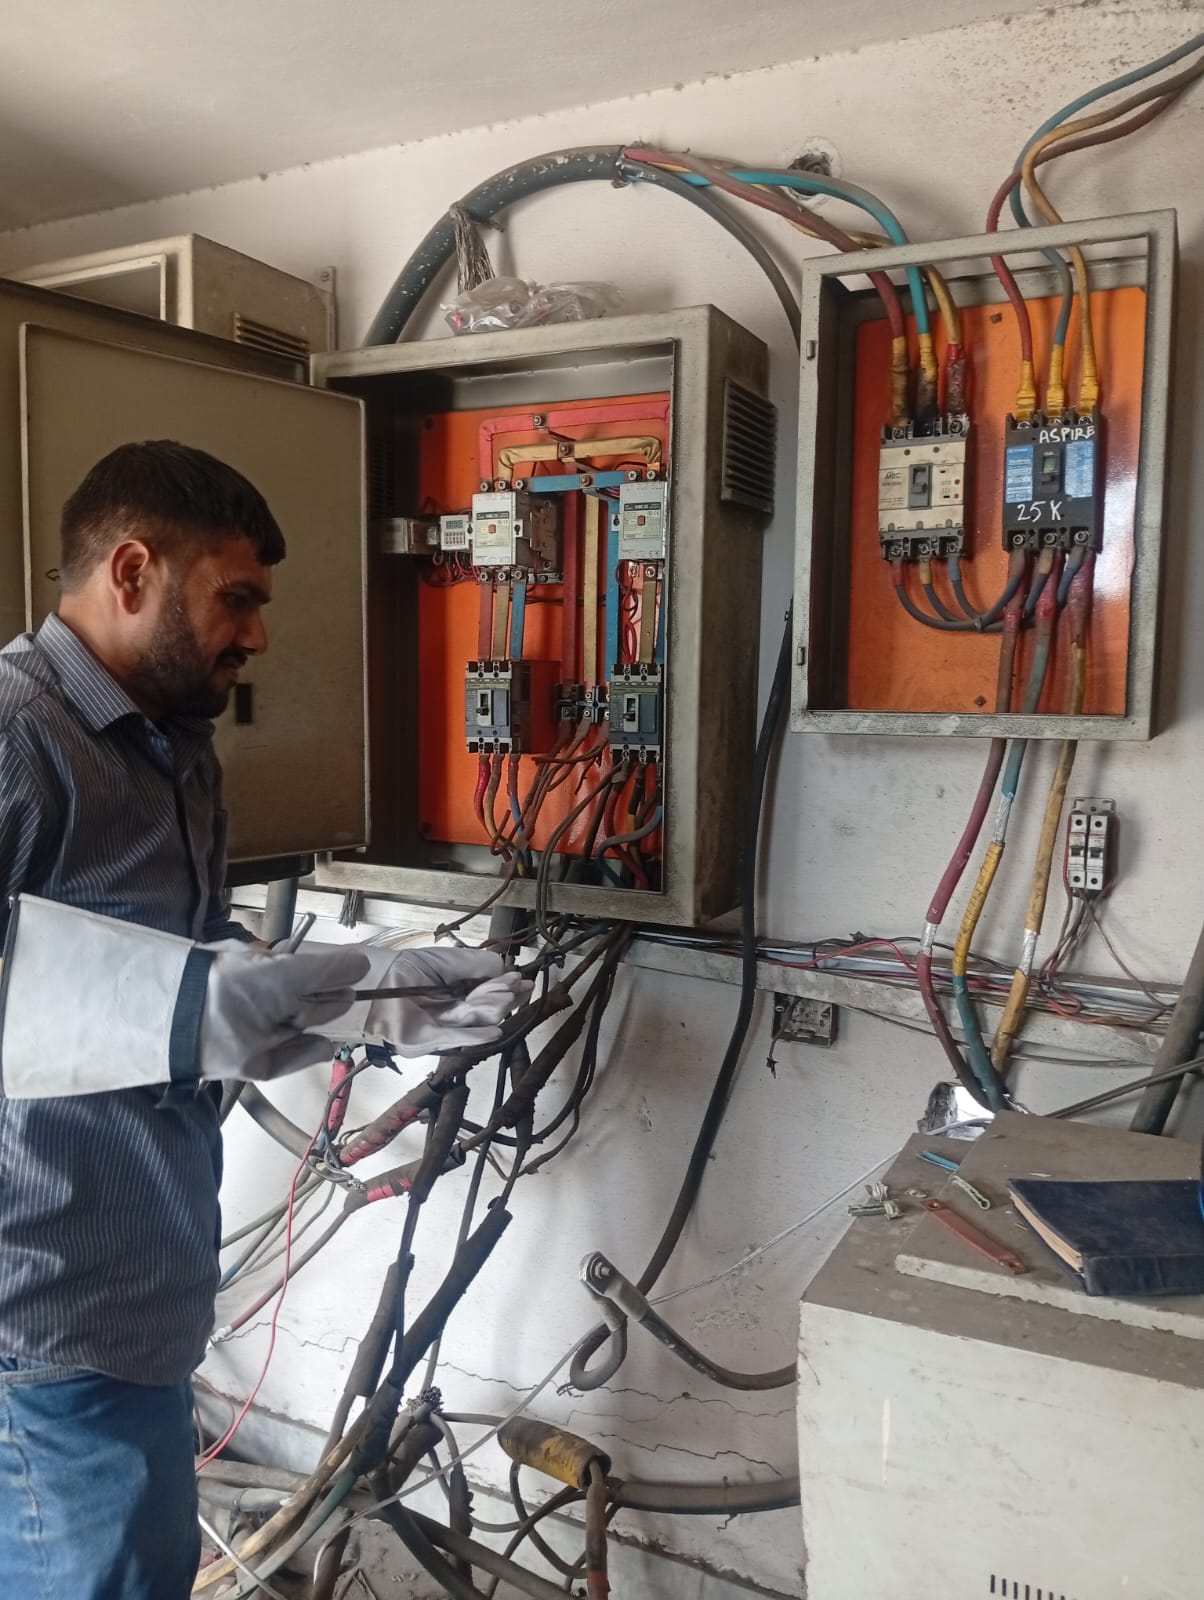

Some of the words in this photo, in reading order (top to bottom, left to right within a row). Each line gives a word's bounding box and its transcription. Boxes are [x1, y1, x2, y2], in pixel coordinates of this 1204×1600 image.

[1039, 425, 1096, 444] ASPIRE
[1017, 500, 1047, 523] 25
[1050, 499, 1063, 521] K
